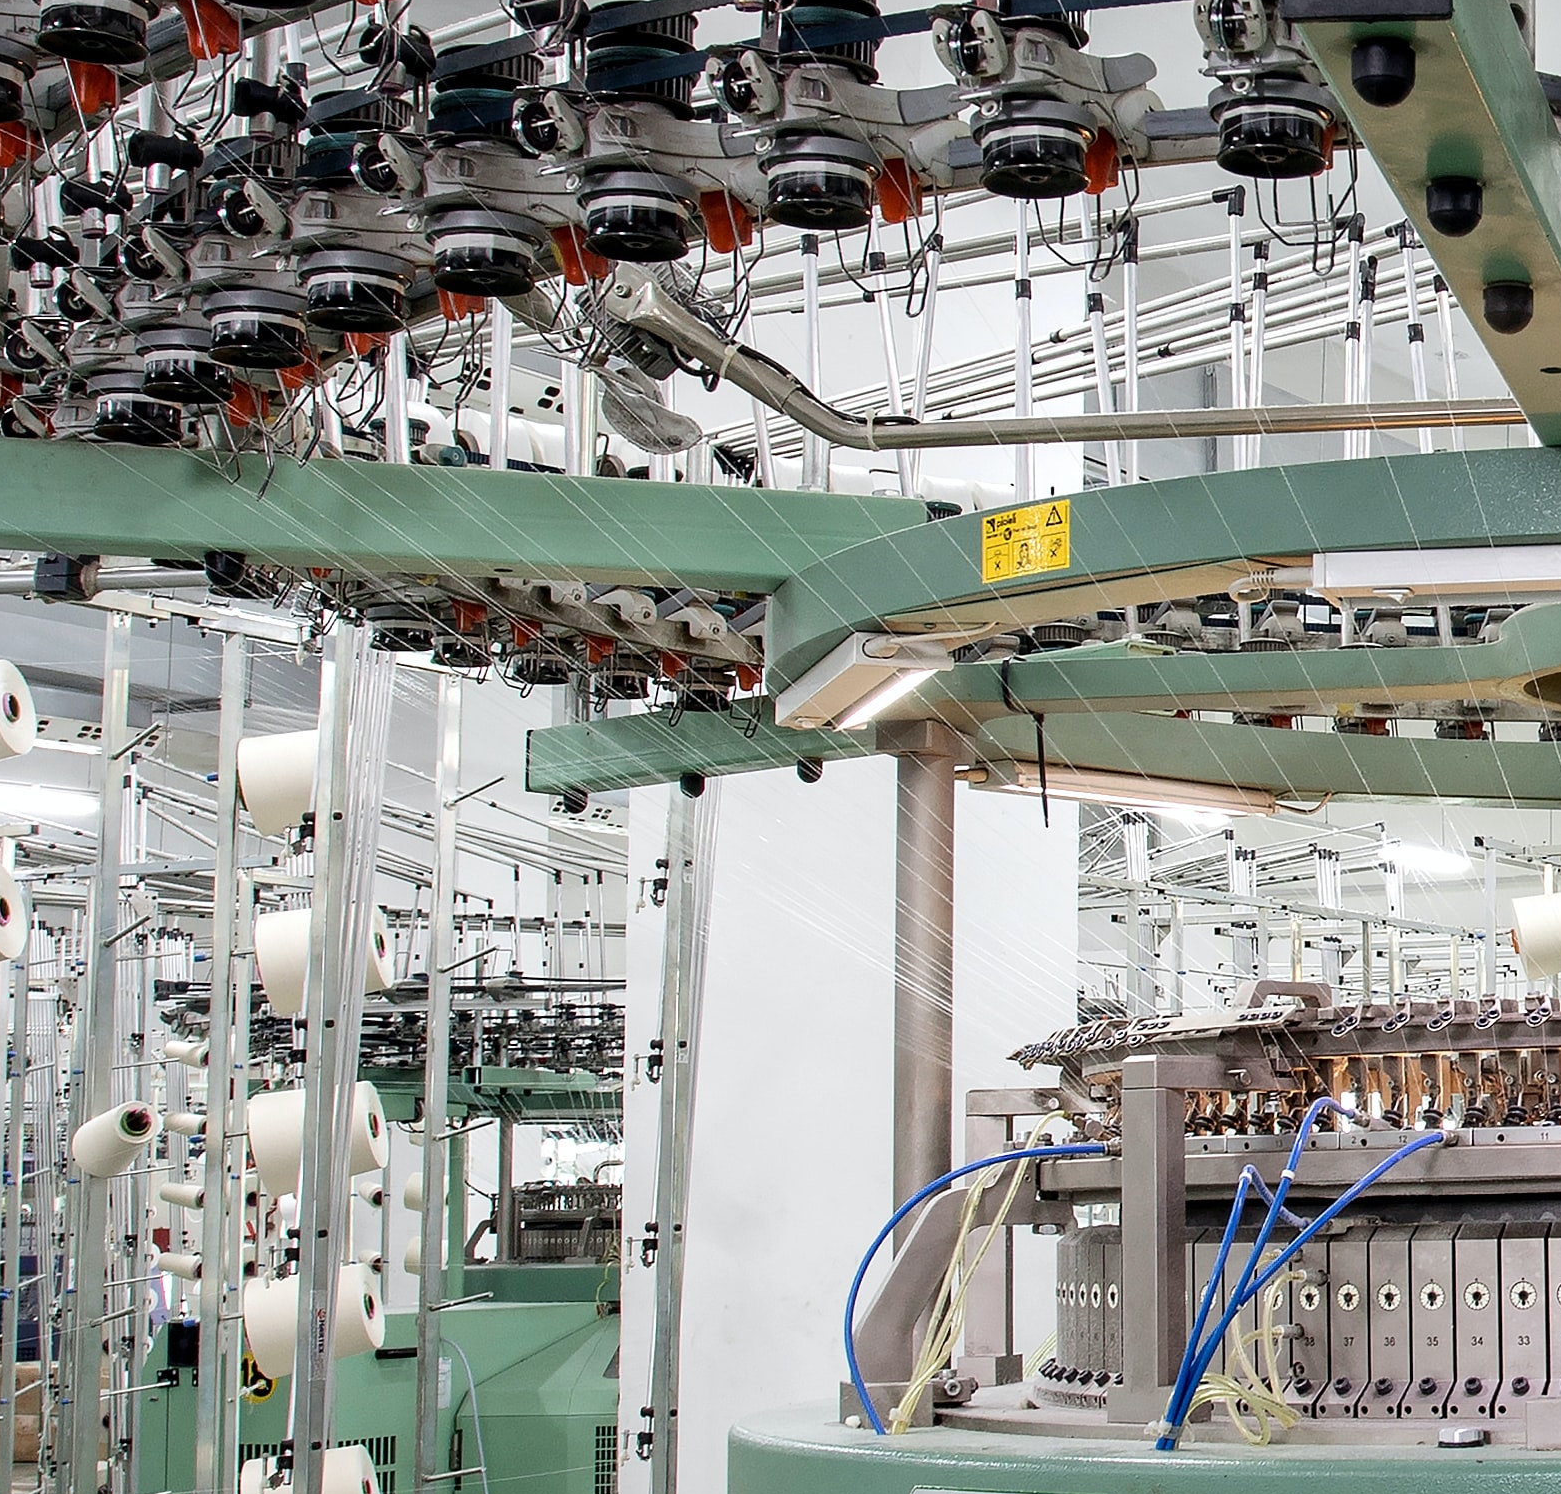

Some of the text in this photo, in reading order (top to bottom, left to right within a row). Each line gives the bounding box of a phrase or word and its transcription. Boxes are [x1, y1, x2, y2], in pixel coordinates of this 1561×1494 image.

[1398, 1134, 1409, 1144] 12
[1540, 1132, 1550, 1141] 11
[1343, 1336, 1355, 1347] 37
[1384, 1336, 1396, 1347] 36
[1426, 1336, 1439, 1347] 35
[1470, 1336, 1484, 1347] 34
[1518, 1335, 1531, 1346] 33
